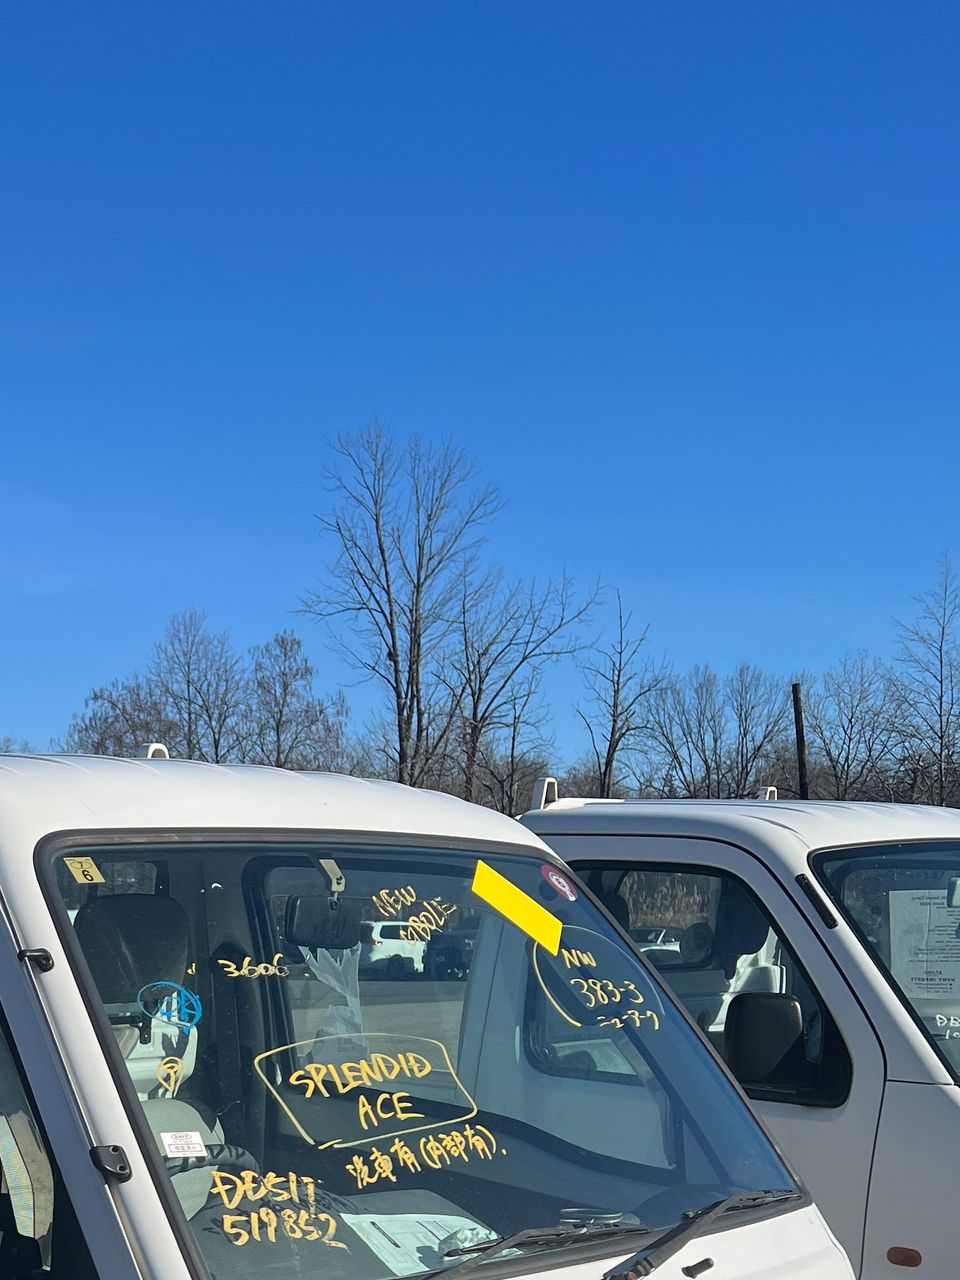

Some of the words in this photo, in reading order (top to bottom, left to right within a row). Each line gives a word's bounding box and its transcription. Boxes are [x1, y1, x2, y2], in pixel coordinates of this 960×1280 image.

[81, 869, 94, 882] 6
[561, 948, 597, 969] NW
[570, 978, 645, 1008] 383-3
[289, 1052, 432, 1098] SPLENDID
[357, 1092, 426, 1130] ACE
